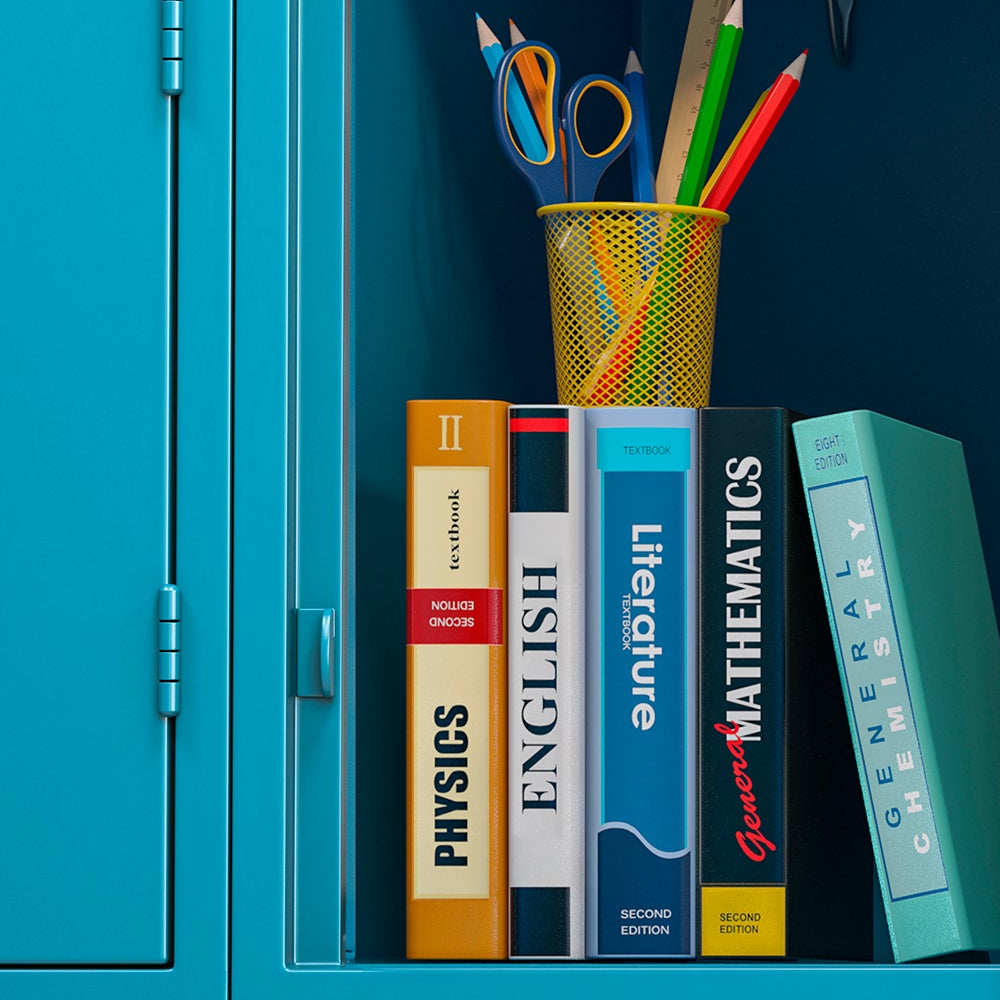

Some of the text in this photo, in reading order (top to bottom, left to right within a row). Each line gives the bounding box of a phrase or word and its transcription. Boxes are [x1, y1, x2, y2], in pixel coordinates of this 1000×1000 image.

[438, 414, 463, 451] II
[623, 445, 672, 456] TEXTBOOK
[815, 434, 840, 451] EIGHT
[814, 451, 849, 471] EDITION
[447, 488, 460, 571] textbook
[431, 600, 475, 611] EDITION
[725, 456, 762, 741] MATHEMATICS
[429, 616, 475, 628] SECOND
[622, 593, 631, 651] TEXTBOOK
[631, 524, 664, 731] Literature
[521, 562, 558, 815] ENGLISH
[836, 560, 902, 828] GENERAL
[847, 519, 931, 855] CHEMISTRY
[433, 704, 469, 867] PHYSICS
[713, 720, 777, 862] General
[620, 908, 672, 920] SECOND
[620, 925, 670, 936] EDITION
[719, 912, 762, 923] SECOND
[719, 924, 759, 934] EDITION
